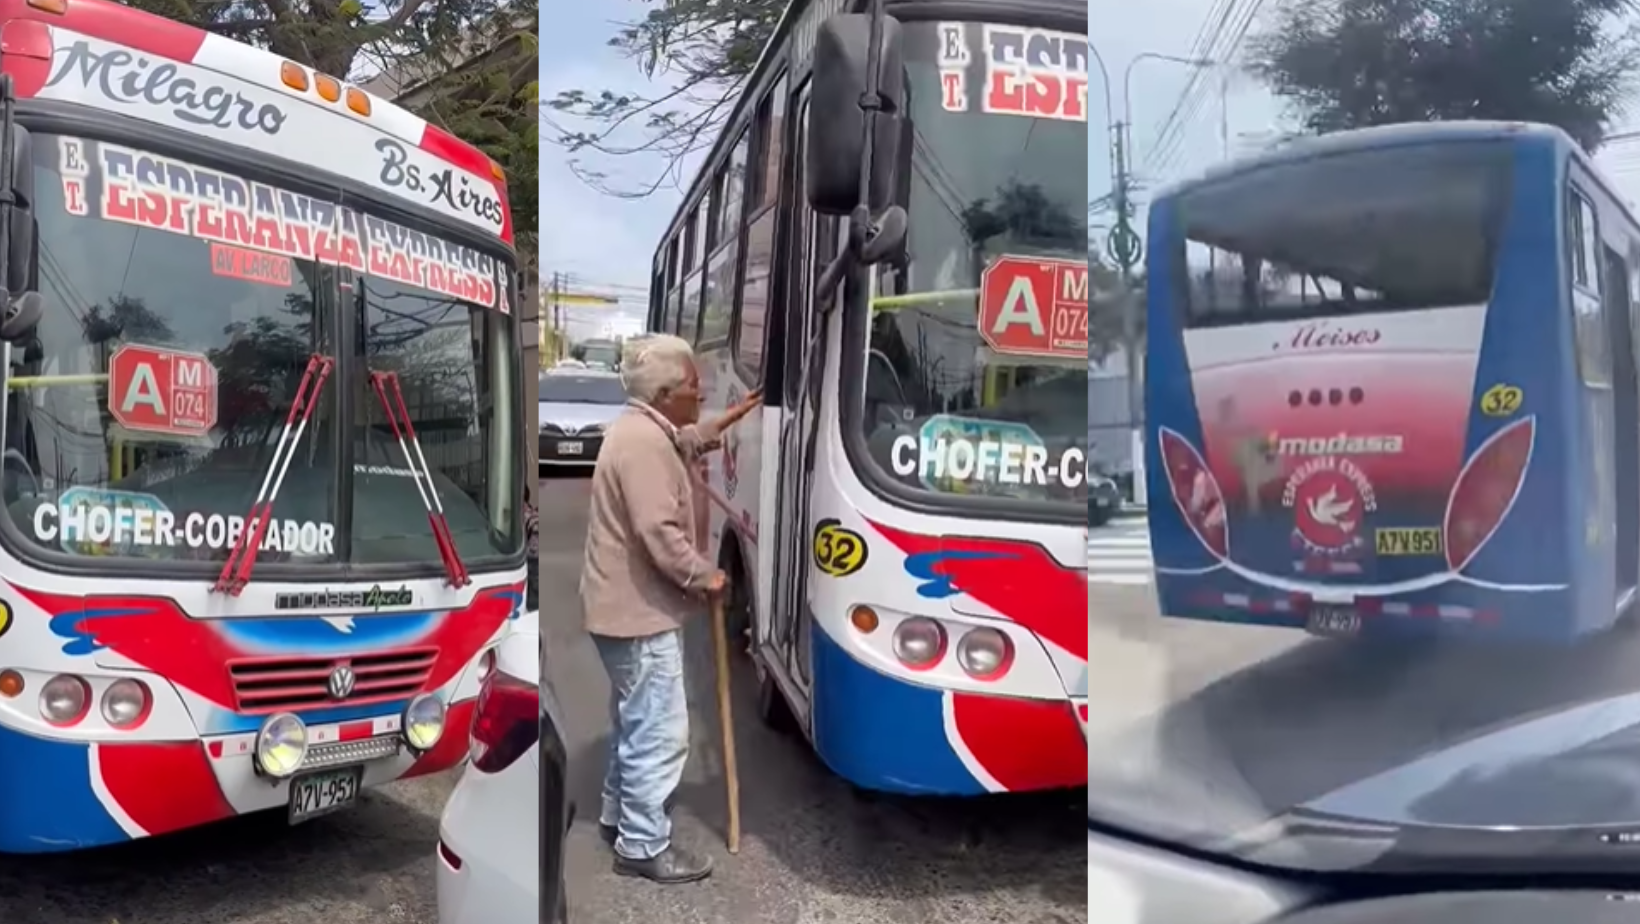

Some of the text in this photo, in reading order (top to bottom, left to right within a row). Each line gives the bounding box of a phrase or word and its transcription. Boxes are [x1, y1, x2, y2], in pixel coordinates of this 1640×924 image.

[46, 41, 287, 134] Milagro
[375, 138, 503, 225] Bs. Aires
[103, 149, 364, 270] ESPERANZA
[366, 214, 495, 307] EXPRESS
[243, 252, 289, 281] LARCO
[1063, 269, 1088, 301] M
[991, 274, 1046, 336] A
[121, 362, 167, 415] A
[178, 360, 202, 388] M
[174, 392, 204, 417] 074
[1486, 389, 1517, 413] 32
[891, 434, 1088, 489] CHOFER-C
[1279, 431, 1403, 456] modasa
[816, 531, 857, 571] 32
[1377, 530, 1441, 553] A7V951
